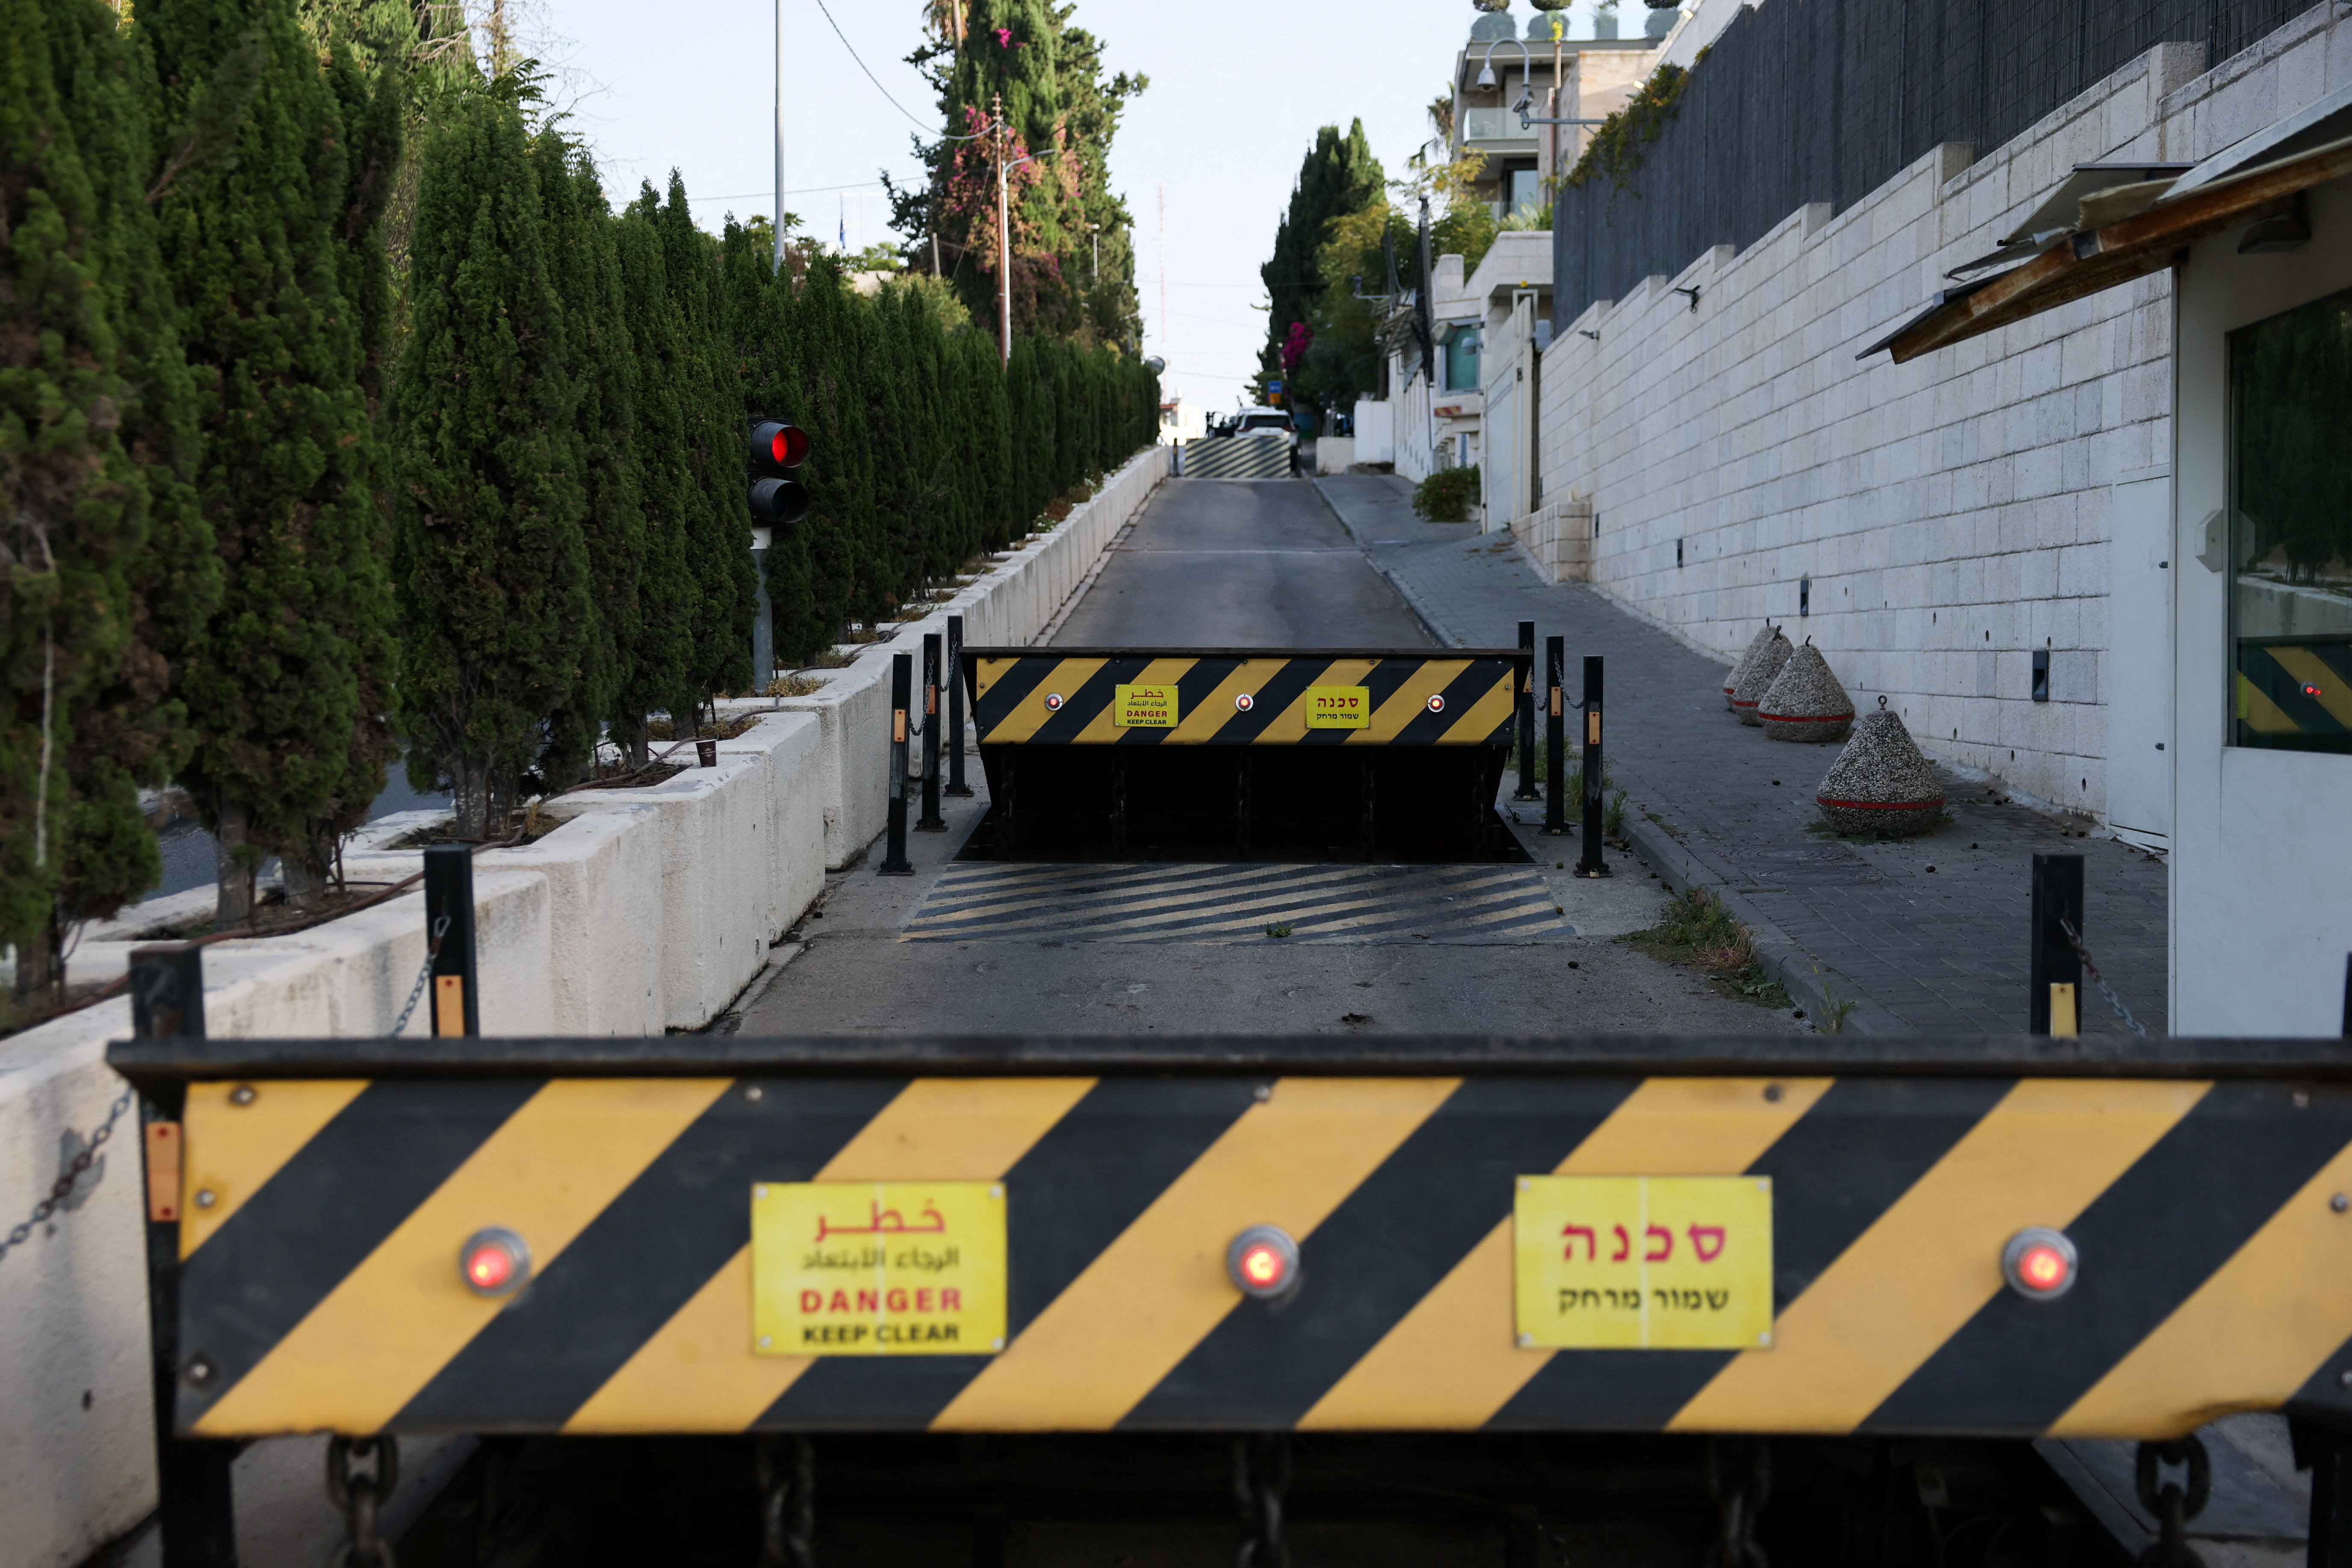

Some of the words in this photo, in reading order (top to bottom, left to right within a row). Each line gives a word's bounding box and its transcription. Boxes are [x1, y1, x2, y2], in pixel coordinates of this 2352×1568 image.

[1130, 689, 1164, 699] خطر
[1317, 697, 1359, 708] סכנה
[814, 1198, 946, 1243] خطر
[1562, 1222, 1726, 1264] סכנה
[894, 1247, 960, 1273] الرجاء
[800, 1287, 962, 1313] DANGER
[1559, 1289, 1641, 1315] מרחק
[1653, 1289, 1729, 1311] שמור
[803, 1325, 867, 1344] KEEP
[875, 1323, 959, 1343] CLEAR
